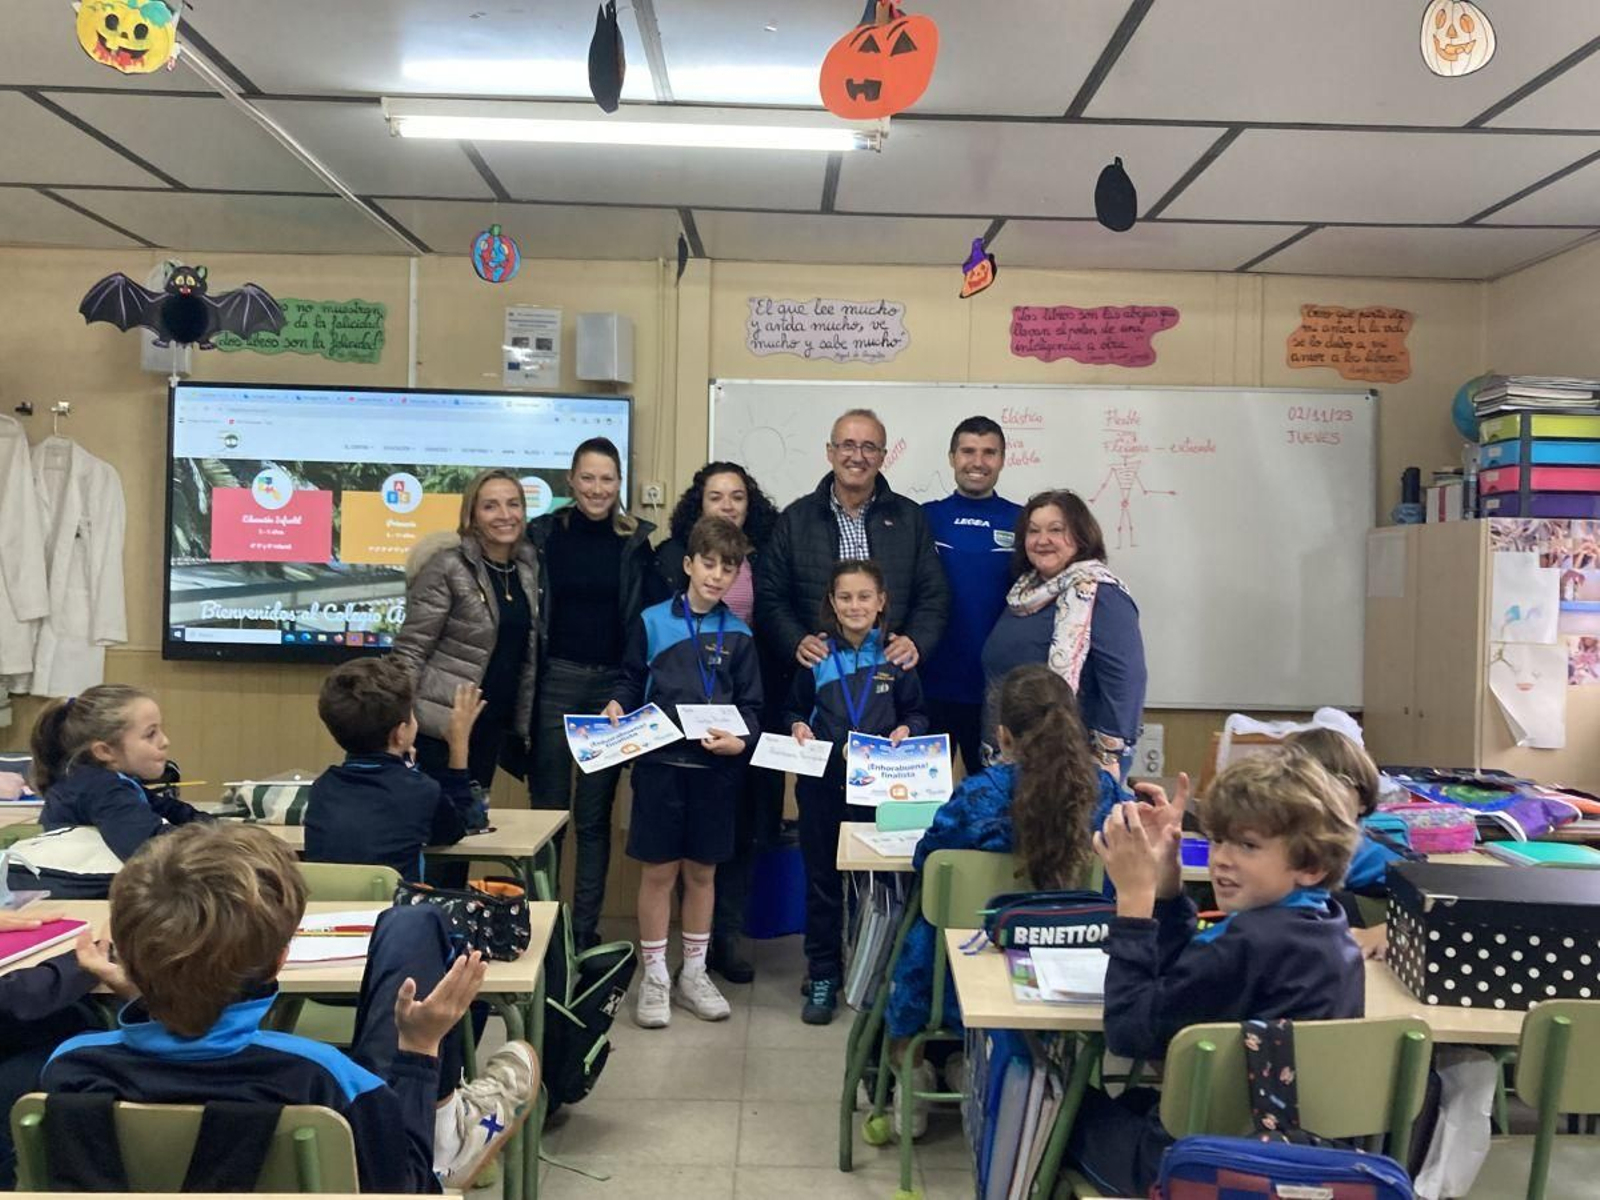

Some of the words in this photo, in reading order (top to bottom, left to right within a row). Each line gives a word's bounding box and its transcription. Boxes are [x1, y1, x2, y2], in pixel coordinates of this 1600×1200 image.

[777, 304, 807, 325] que
[814, 298, 834, 316] lee
[841, 299, 899, 316] mucho
[751, 321, 762, 341] y
[750, 332, 800, 349] mucho
[803, 340, 815, 359] y
[819, 333, 848, 350] sabe
[200, 599, 296, 622] Bienvenidos
